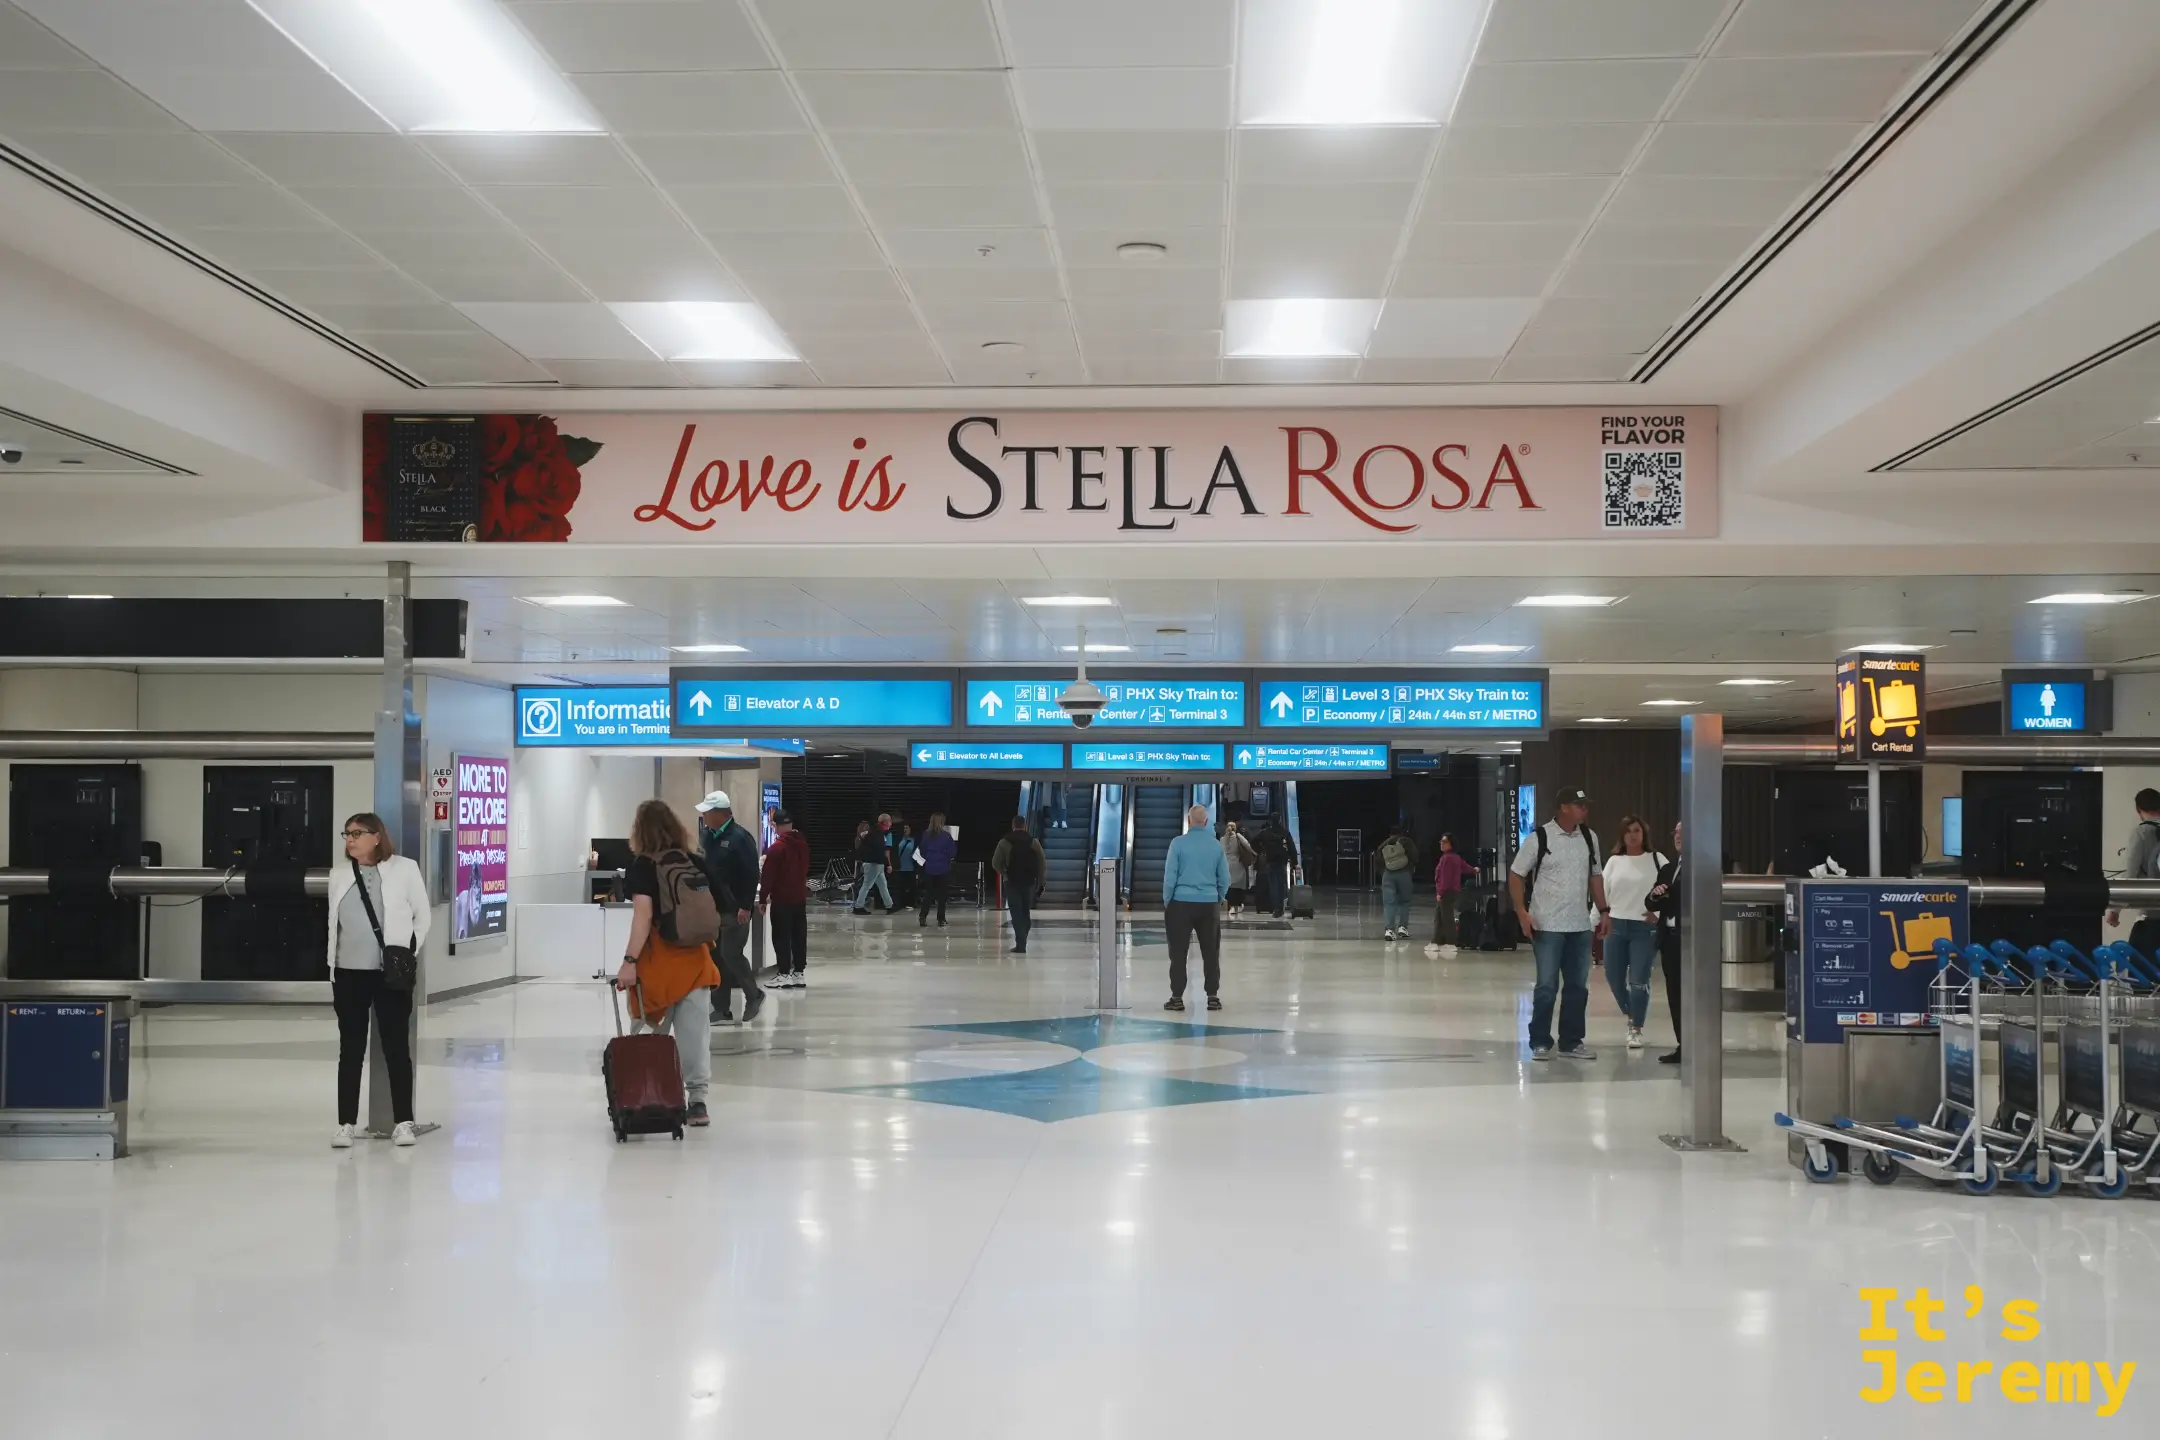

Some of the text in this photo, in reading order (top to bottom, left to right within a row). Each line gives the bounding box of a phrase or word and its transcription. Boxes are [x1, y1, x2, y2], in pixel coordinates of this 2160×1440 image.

[1601, 416, 1685, 428] FIND YOUR
[1601, 428, 1685, 445] FLAVOR
[400, 468, 436, 485] STELLA
[634, 423, 821, 531] Love
[838, 437, 906, 512] is
[946, 416, 1265, 530] STELLA
[1862, 659, 1920, 672] smartecarte
[1126, 688, 1238, 703] PHX Sky Train to:
[1342, 688, 1529, 703] Level 3 PHX Sky Train to:
[568, 699, 670, 719] Informati
[746, 697, 840, 709] Elevator A & D
[1100, 708, 1138, 719] Center
[1140, 708, 1146, 720] /
[1169, 709, 1217, 719] Terminal
[1220, 708, 1228, 719] 3
[1323, 709, 1378, 722] Economy
[1379, 709, 1386, 720] /
[1408, 709, 1432, 720] 24th
[1434, 709, 1441, 720] /
[1442, 709, 1467, 720] 44th
[1468, 711, 1482, 720] ST
[1484, 709, 1490, 720] /
[1492, 710, 1537, 721] METRO
[2024, 717, 2072, 728] WOMEN
[574, 723, 595, 735] You
[597, 725, 616, 735] are
[618, 723, 628, 734] in
[1872, 742, 1913, 753] Cart Rental
[949, 752, 1023, 760] Elevator to All Levels
[1107, 752, 1211, 762] Level 3 PHX Sky Train to:
[1267, 759, 1297, 768] Economy
[1360, 759, 1385, 767] METRO
[433, 768, 452, 776] AED
[459, 763, 507, 793] MORE TO
[459, 796, 507, 825] EXPLORE!
[1509, 789, 1517, 853] DIRECTORY
[1879, 891, 1957, 903] smartecarte
[1821, 908, 1831, 916] Pay
[19, 1008, 38, 1016] RENT
[57, 1008, 86, 1016] RETURN
